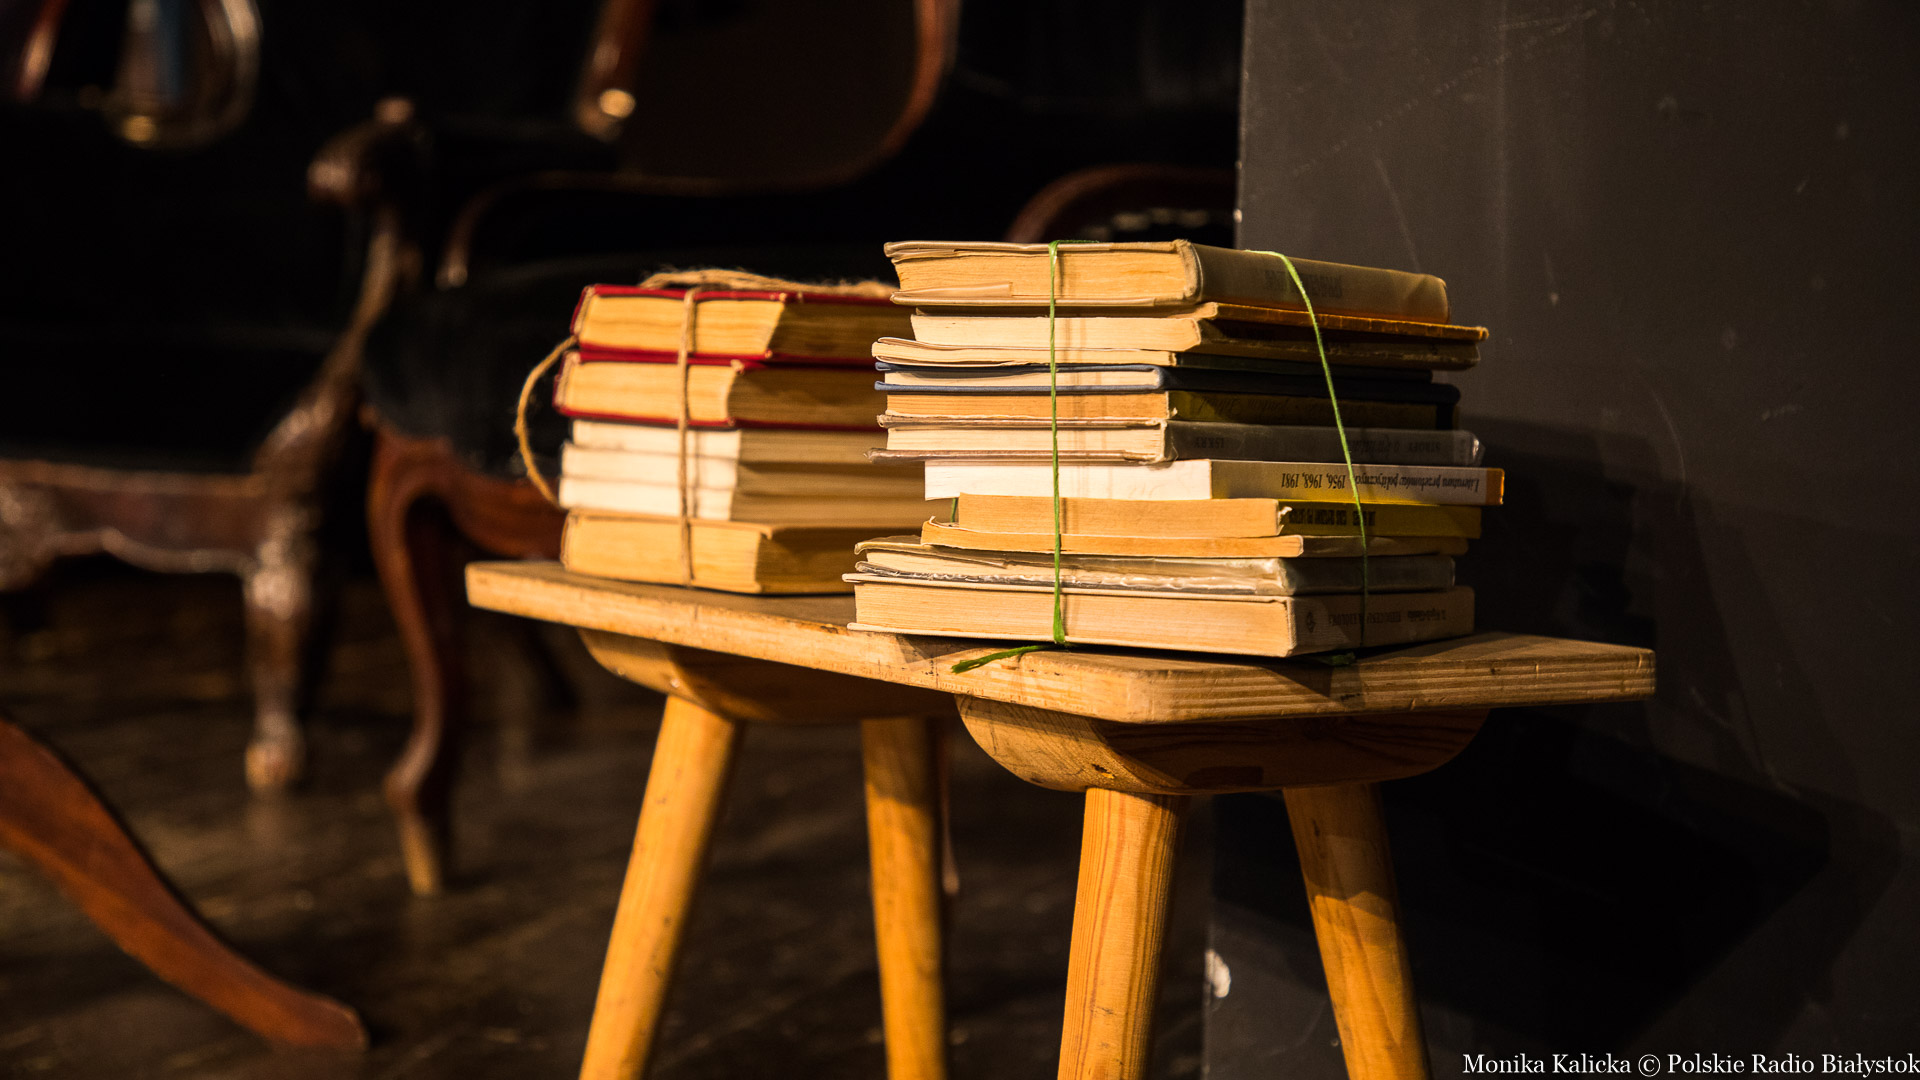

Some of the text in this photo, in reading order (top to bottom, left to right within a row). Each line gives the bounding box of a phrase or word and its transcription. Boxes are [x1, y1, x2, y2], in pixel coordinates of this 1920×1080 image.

[1282, 473, 1299, 488] 1981
[1302, 472, 1322, 489] 1968,
[1326, 472, 1346, 489] 1956,
[1443, 478, 1480, 492] Literatura
